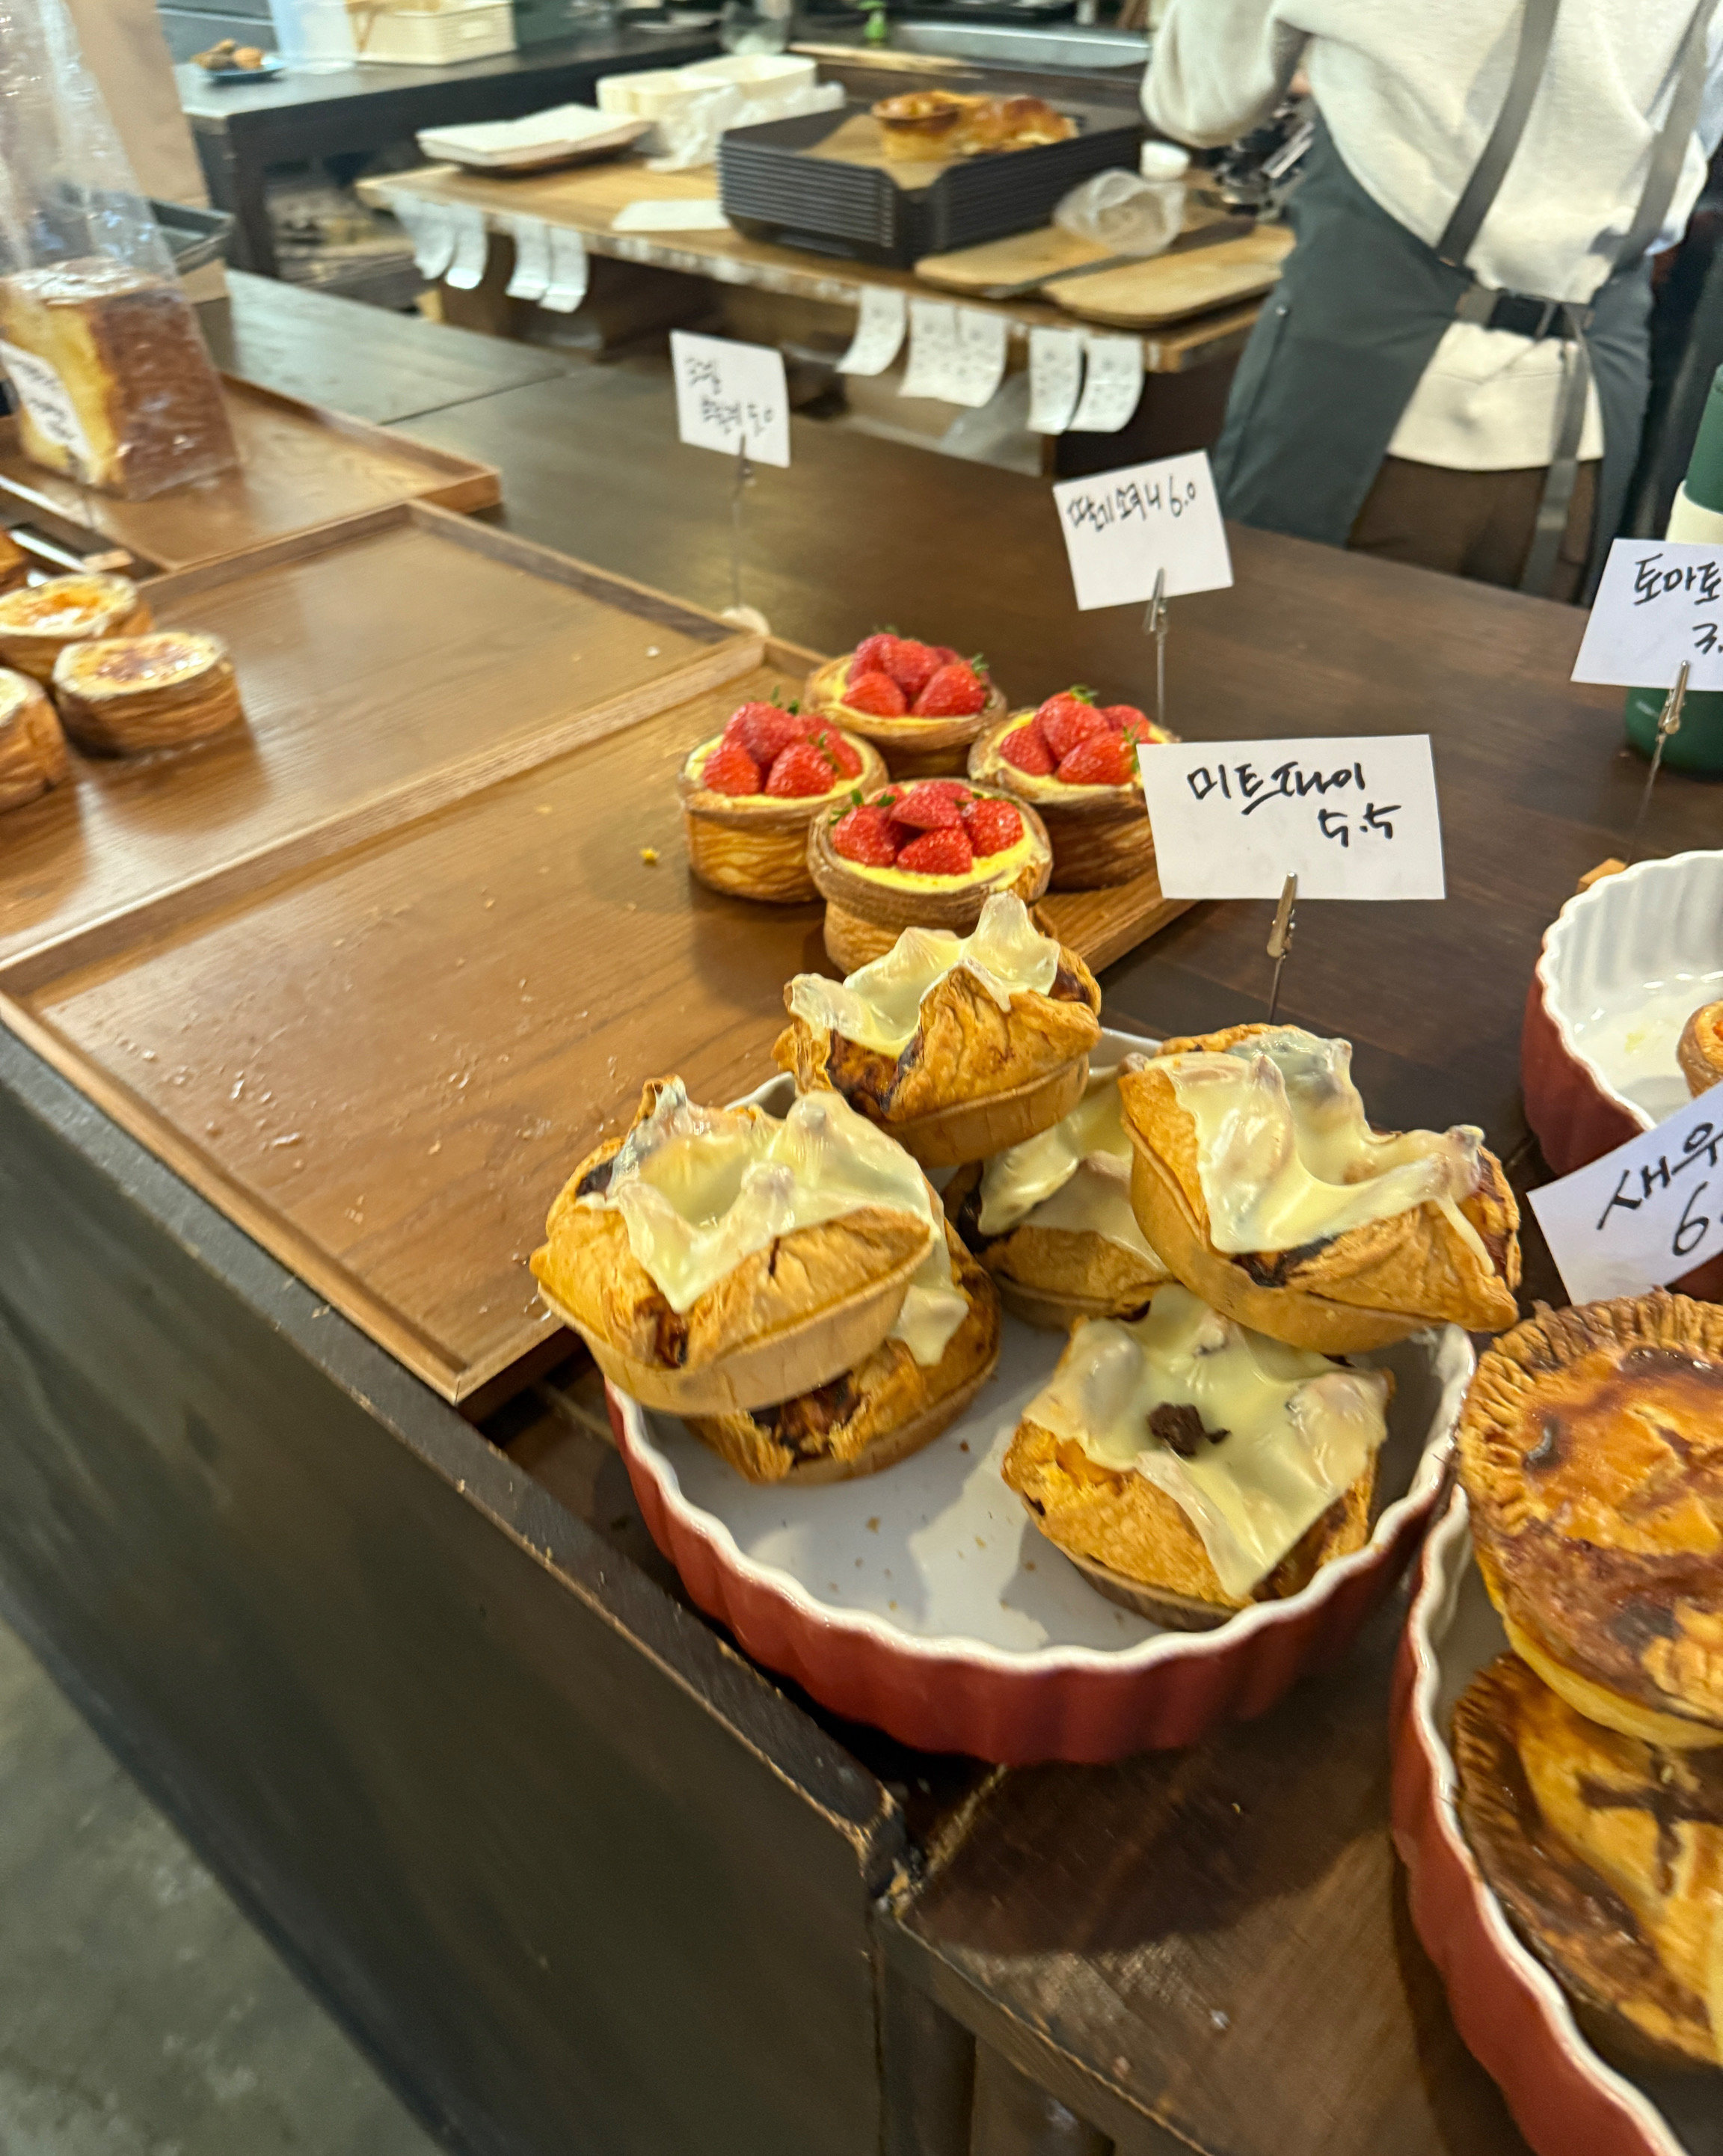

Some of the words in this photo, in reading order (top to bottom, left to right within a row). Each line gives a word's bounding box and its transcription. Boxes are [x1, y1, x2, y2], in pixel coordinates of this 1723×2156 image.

[1168, 474, 1197, 517] 6.0
[1633, 553, 1723, 606] 토마토
[1187, 761, 1366, 816] 미트파이
[1318, 802, 1402, 848] 5.5
[1596, 1122, 1723, 1231] 새우
